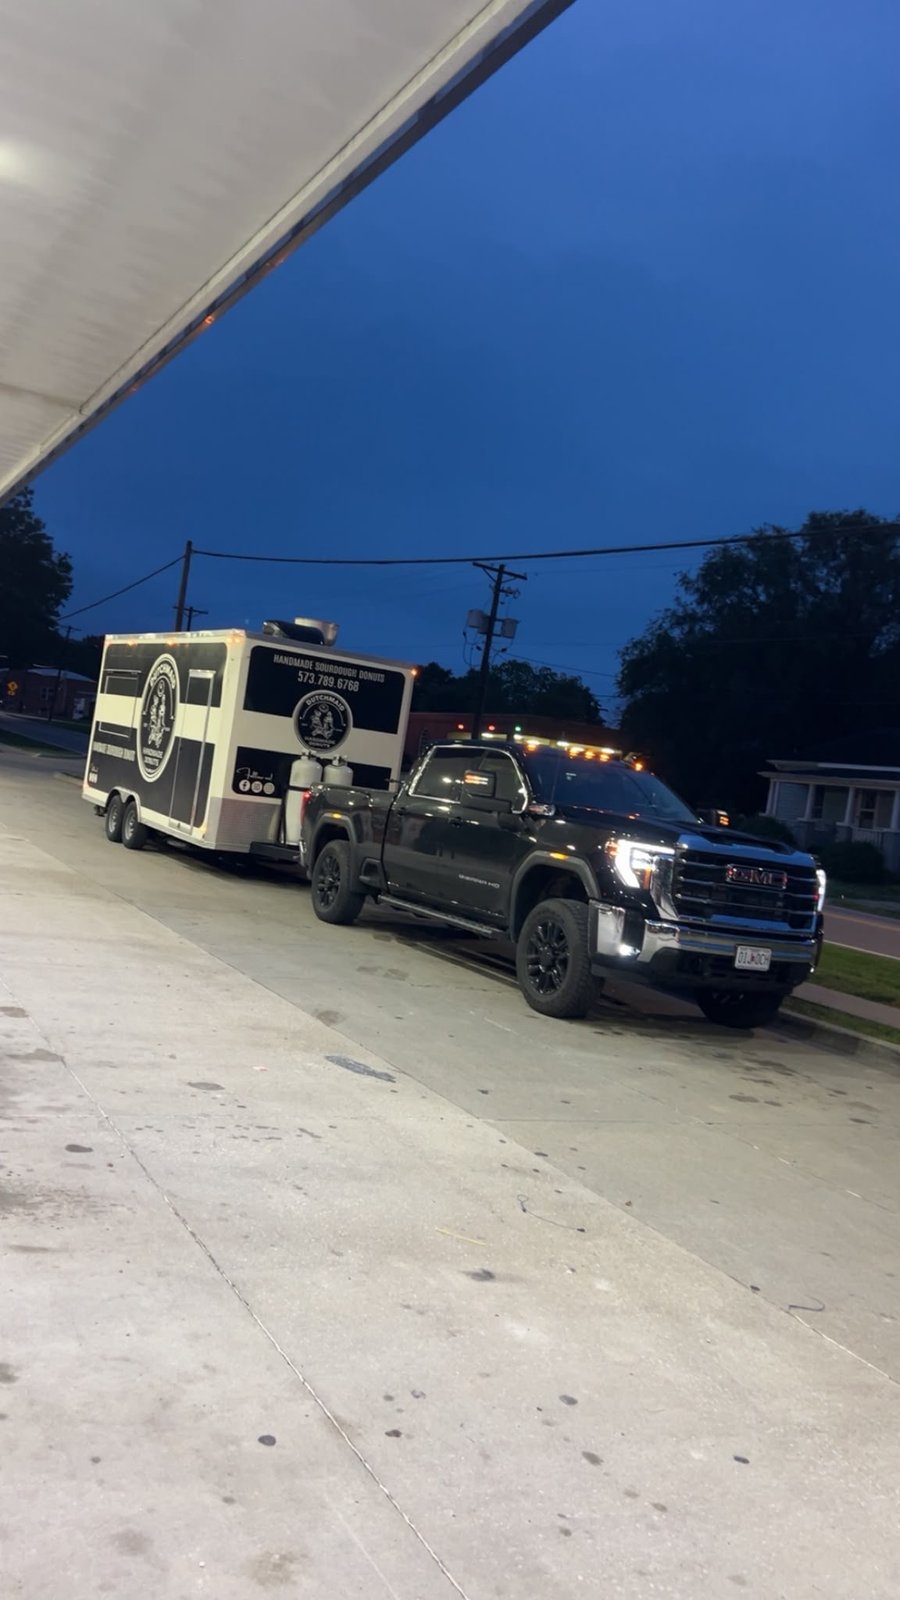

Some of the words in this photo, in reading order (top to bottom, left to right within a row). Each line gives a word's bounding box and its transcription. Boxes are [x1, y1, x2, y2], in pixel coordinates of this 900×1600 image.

[273, 654, 314, 670] HANDMADE
[314, 661, 358, 678] SOURDOUGH
[359, 669, 385, 683] DONUTS
[297, 670, 360, 692] 573.789.6768
[305, 694, 346, 712] DUTCHMAID
